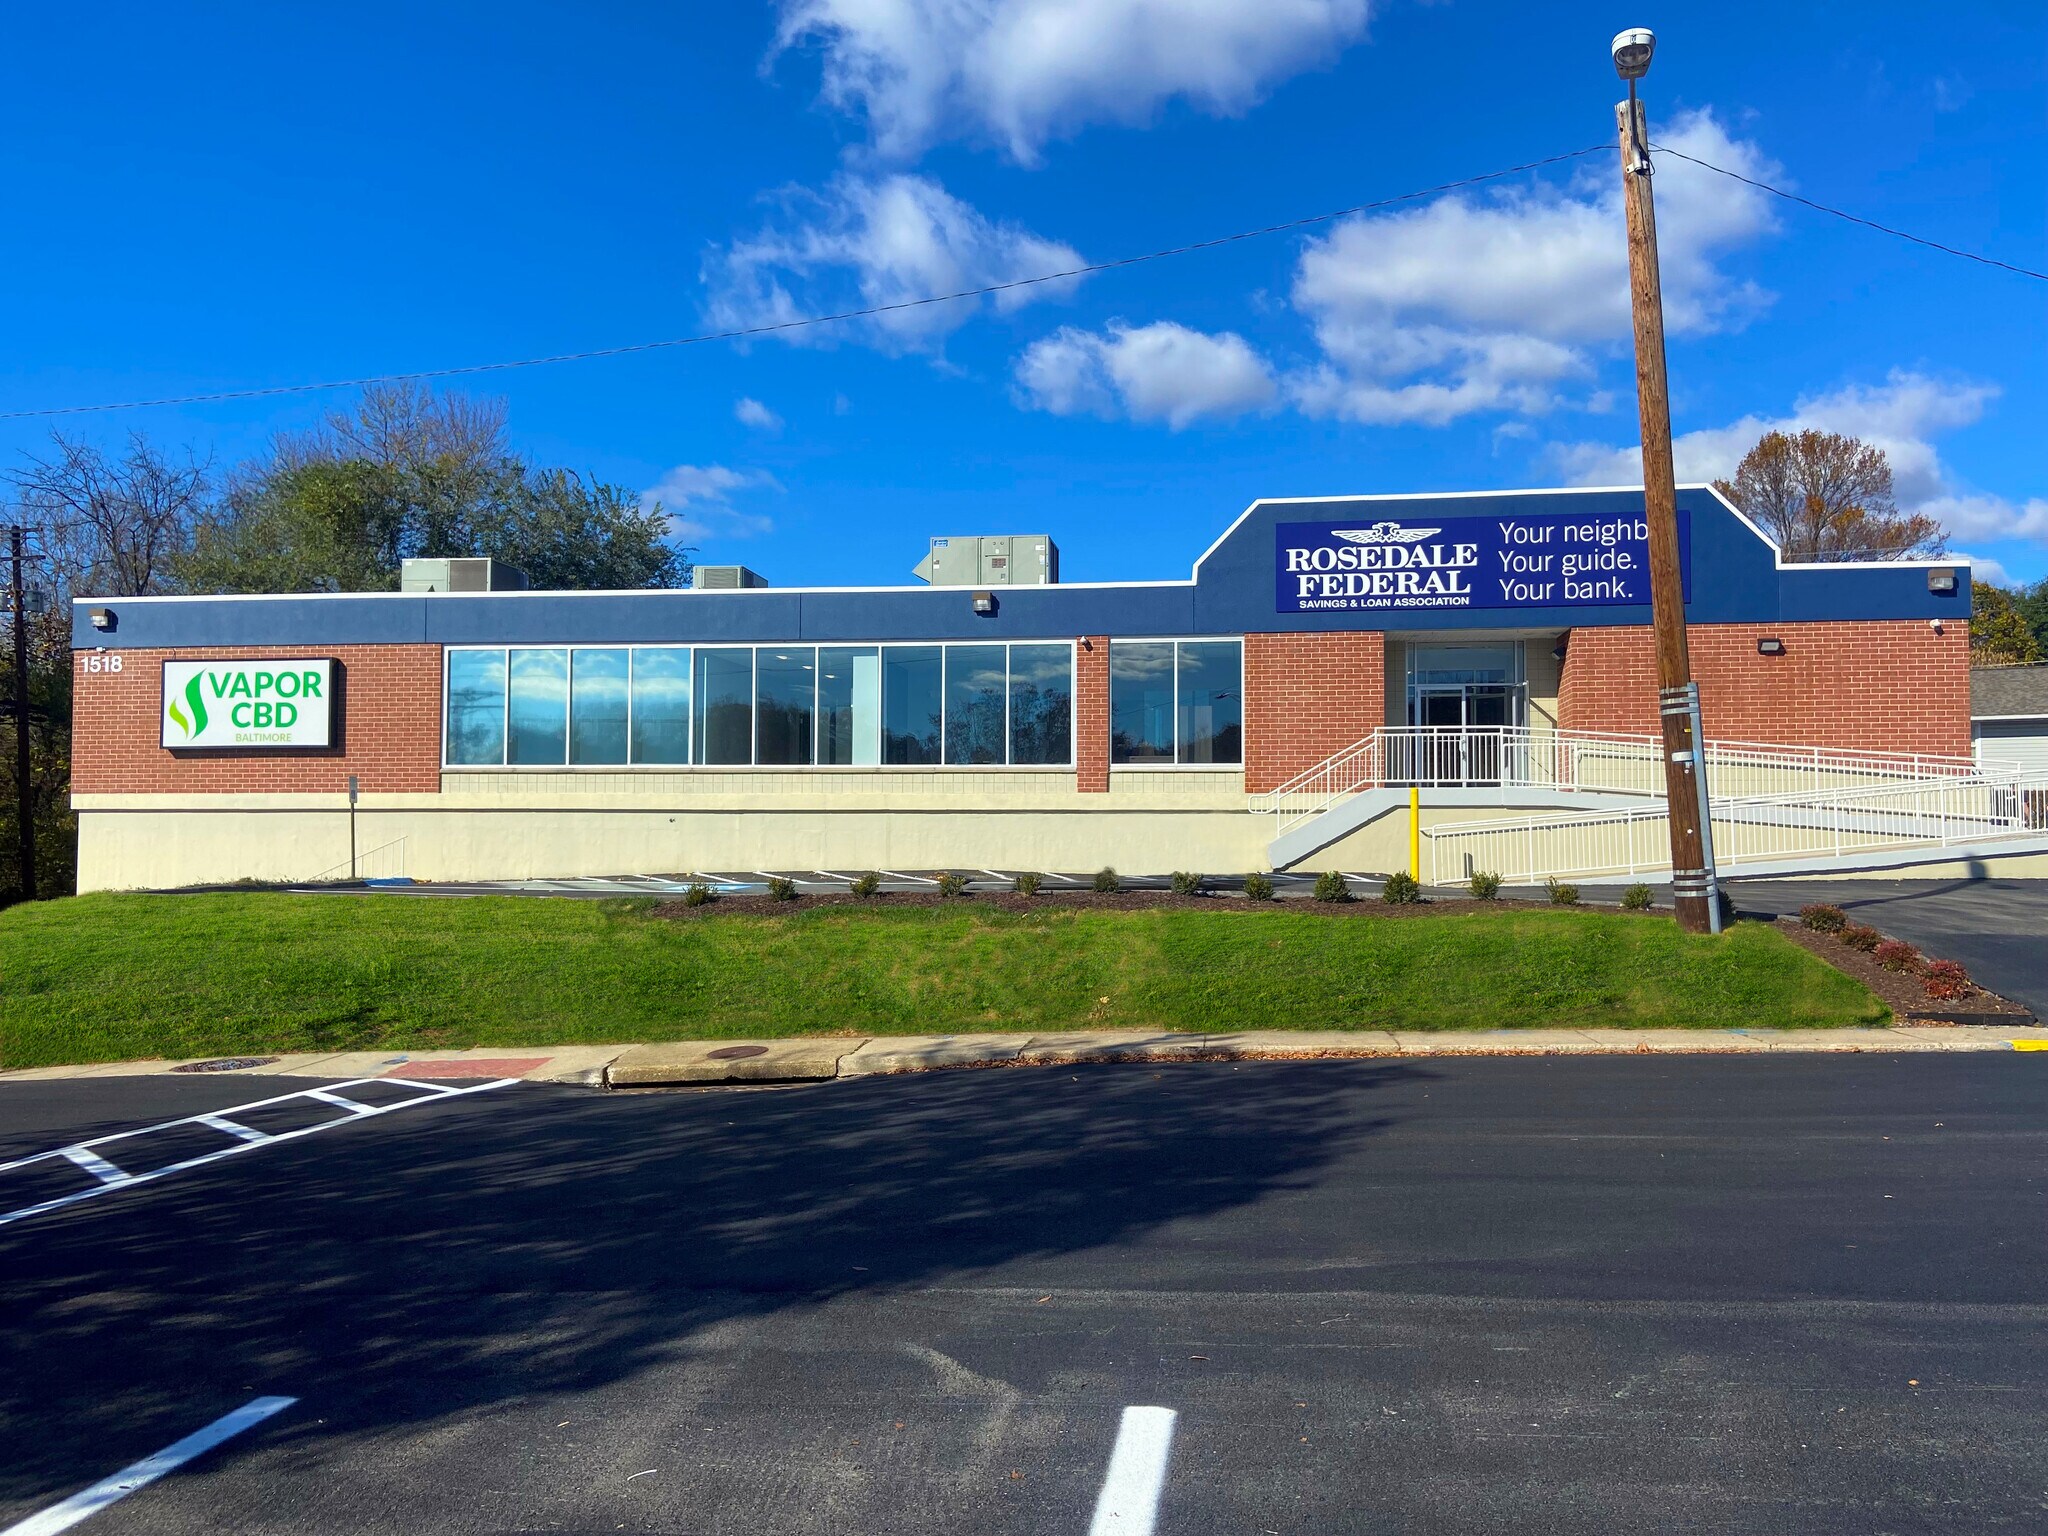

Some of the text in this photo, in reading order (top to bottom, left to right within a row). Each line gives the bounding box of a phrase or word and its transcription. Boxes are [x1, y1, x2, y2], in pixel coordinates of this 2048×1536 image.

[1498, 519, 1648, 546] Your neighb
[1285, 543, 1478, 573] ROSEDALE
[1498, 547, 1637, 575] Your guide.
[1296, 570, 1471, 598] FEDERAL
[1498, 575, 1633, 601] Your bank.
[1299, 596, 1470, 609] SAVINGS & LOAN ASSOCIATION
[80, 655, 123, 673] 1518
[207, 670, 323, 699] VAPOR
[230, 701, 299, 729] CBD
[235, 732, 292, 743] BALTIMORE
